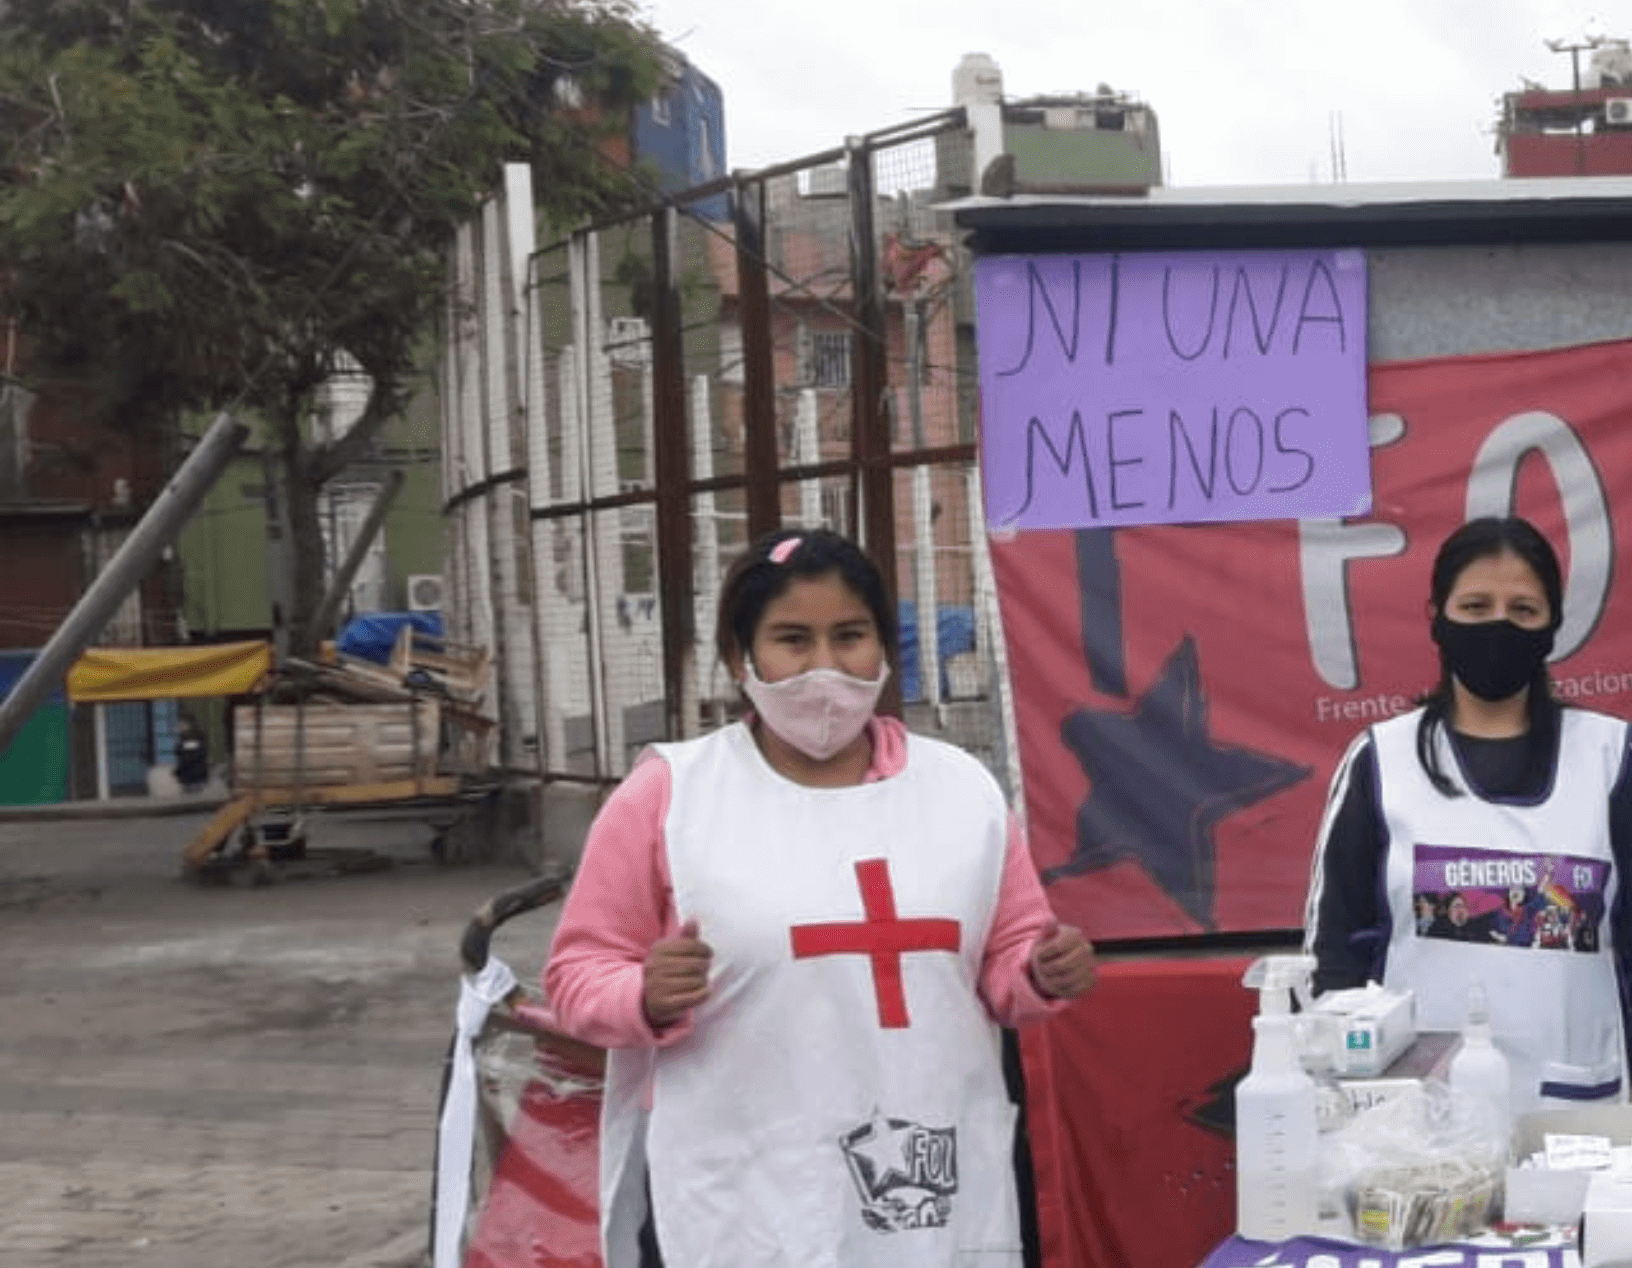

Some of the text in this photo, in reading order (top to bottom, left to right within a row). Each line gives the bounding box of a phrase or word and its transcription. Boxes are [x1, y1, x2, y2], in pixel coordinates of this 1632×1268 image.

[996, 254, 1346, 376] NI UNA
[1001, 407, 1315, 525] MENOS
[1316, 692, 1413, 723] Frente
[909, 1130, 955, 1187] FOL
